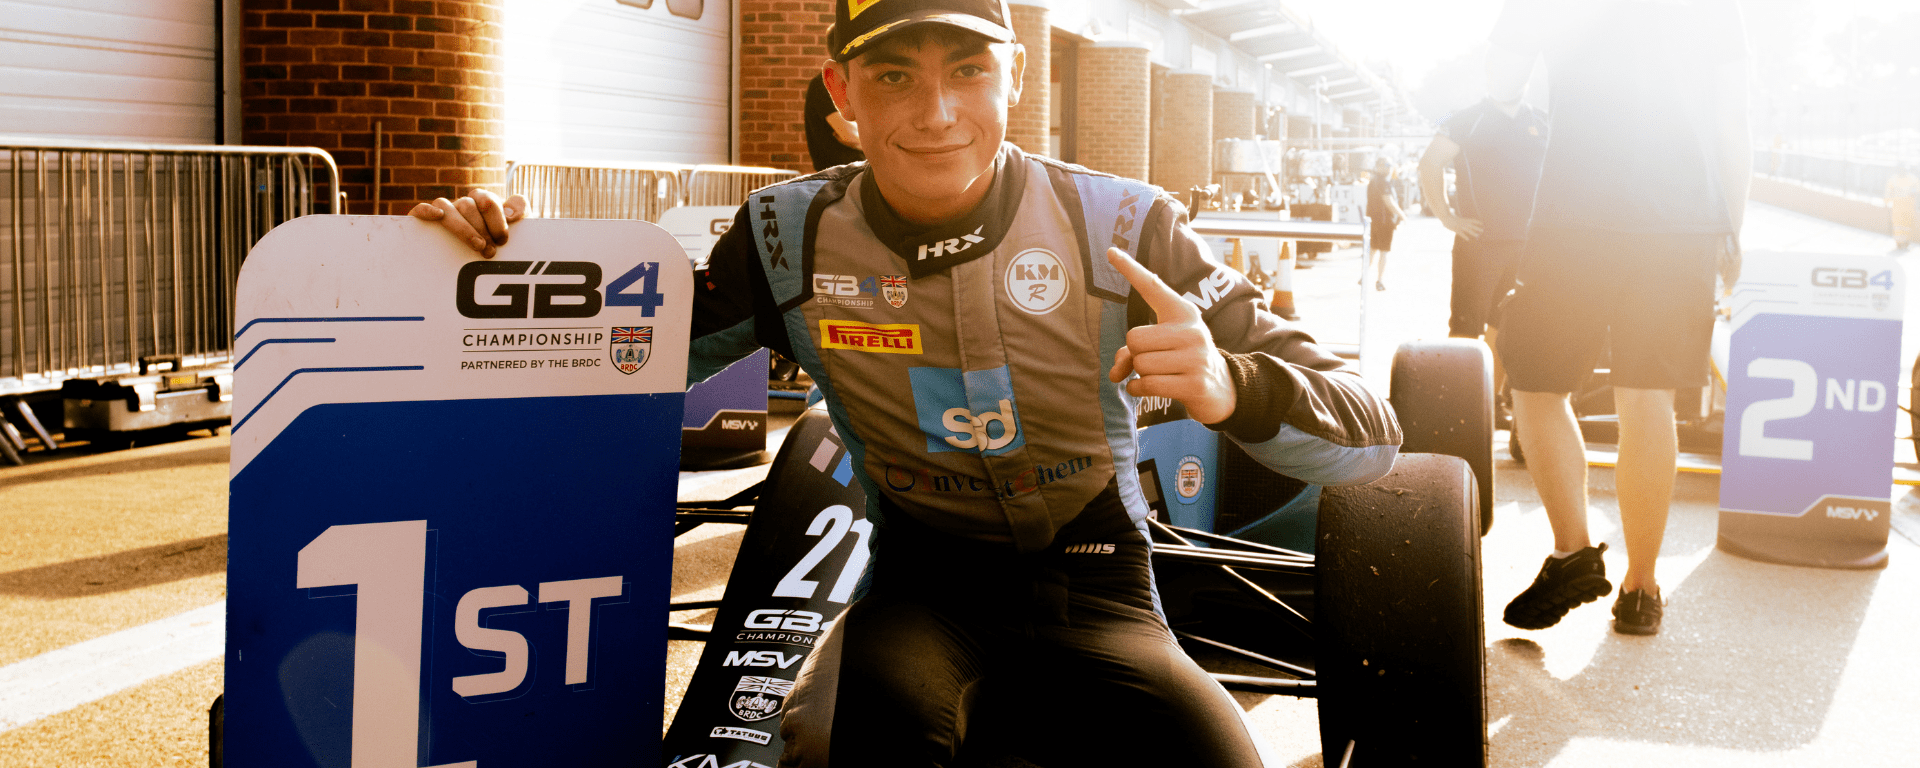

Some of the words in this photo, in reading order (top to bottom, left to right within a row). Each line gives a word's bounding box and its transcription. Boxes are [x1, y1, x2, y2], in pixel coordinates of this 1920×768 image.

[760, 195, 789, 271] HRX
[917, 224, 985, 261] HRX
[1015, 264, 1059, 281] KM
[1811, 267, 1894, 290] GB4
[456, 260, 664, 319] GB4
[812, 273, 879, 297] GB4
[1027, 283, 1048, 302] R
[816, 297, 874, 307] CHAMPIONSHIP
[462, 332, 603, 347] CHAMPIONSHIP
[827, 324, 914, 349] PIRELLI
[461, 359, 528, 370] PARTNERED
[530, 359, 545, 369] BY
[548, 359, 569, 368] THE
[572, 358, 601, 368] BRDC
[620, 363, 638, 372] BRDC
[722, 419, 747, 430] MSV
[1826, 505, 1863, 520] MSV
[771, 504, 874, 604] 21
[736, 632, 817, 646] CHAMPION
[722, 650, 804, 670] MSV
[738, 709, 763, 720] BRDC
[729, 729, 768, 742] TATUUS
